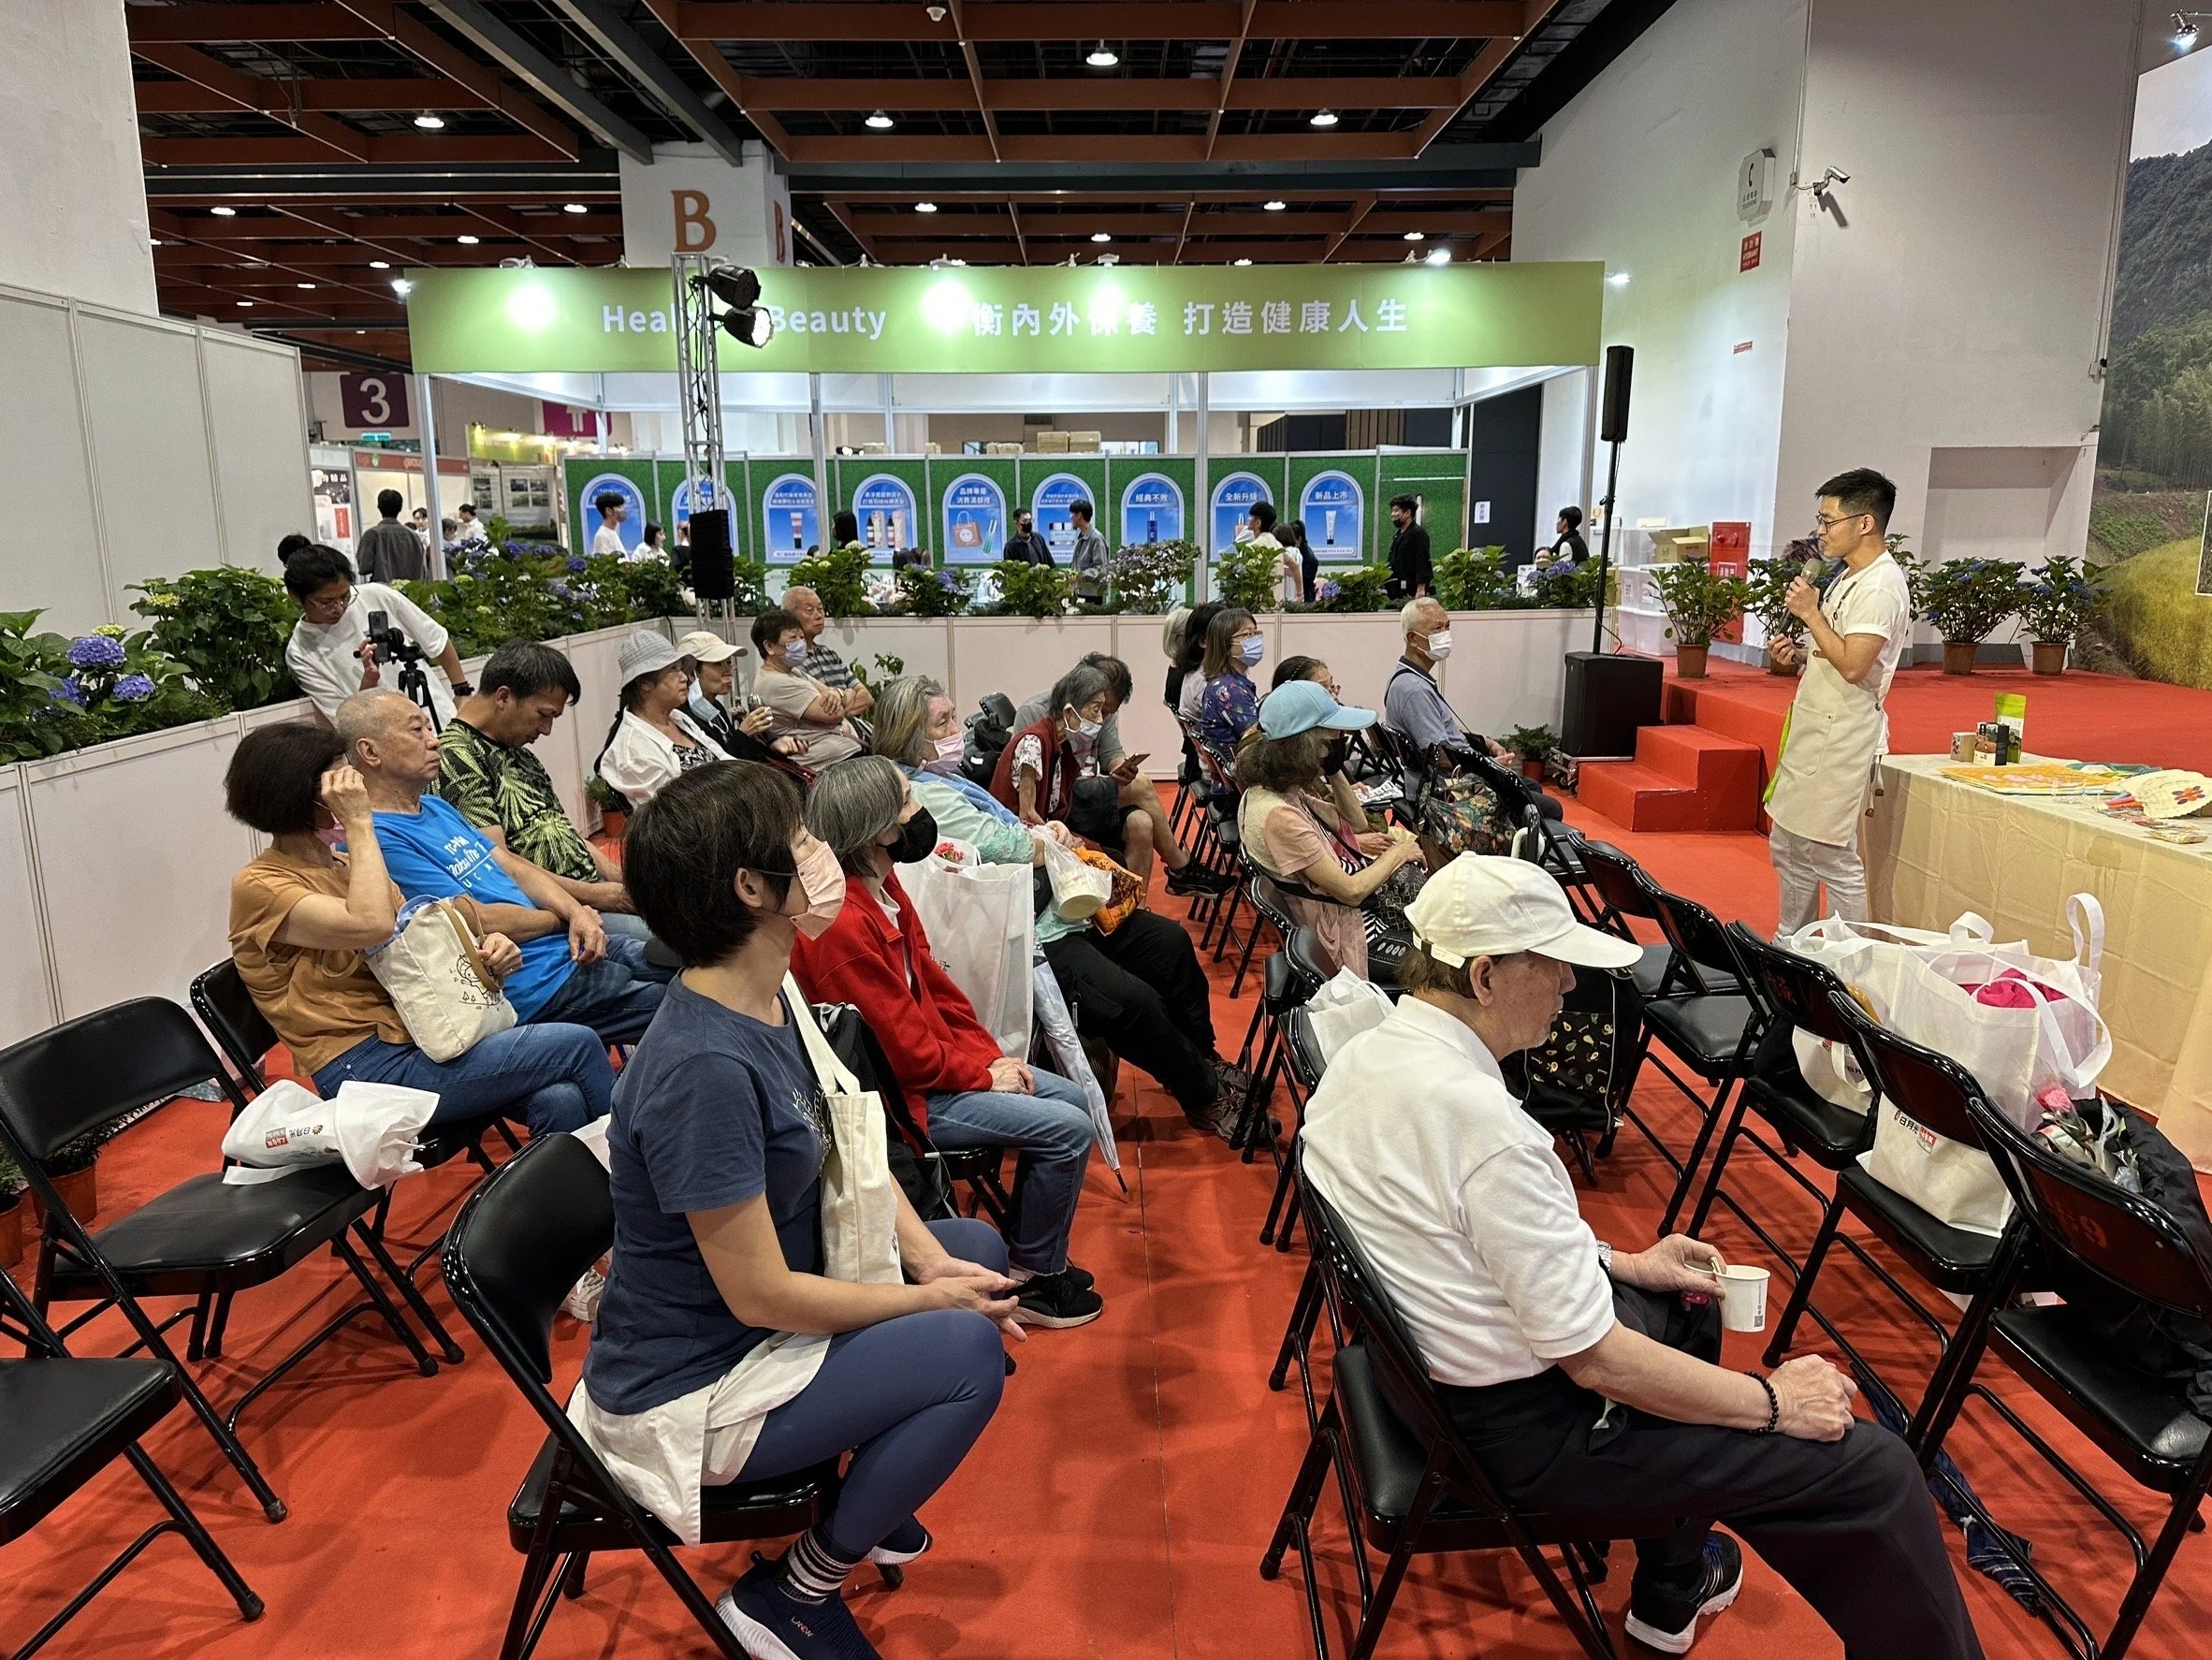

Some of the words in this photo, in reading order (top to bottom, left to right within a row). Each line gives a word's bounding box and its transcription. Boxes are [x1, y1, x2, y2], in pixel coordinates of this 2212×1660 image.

[671, 190, 717, 253] B
[602, 304, 681, 333] Heal
[768, 305, 886, 341] Beauty
[938, 301, 1158, 337] 衡內外養
[1183, 299, 1409, 335] 打造健康人生
[359, 377, 391, 425] 3
[1315, 490, 1348, 501] 新品上市
[288, 1127, 311, 1139] 日月光
[1899, 1115, 1920, 1135] 日月光
